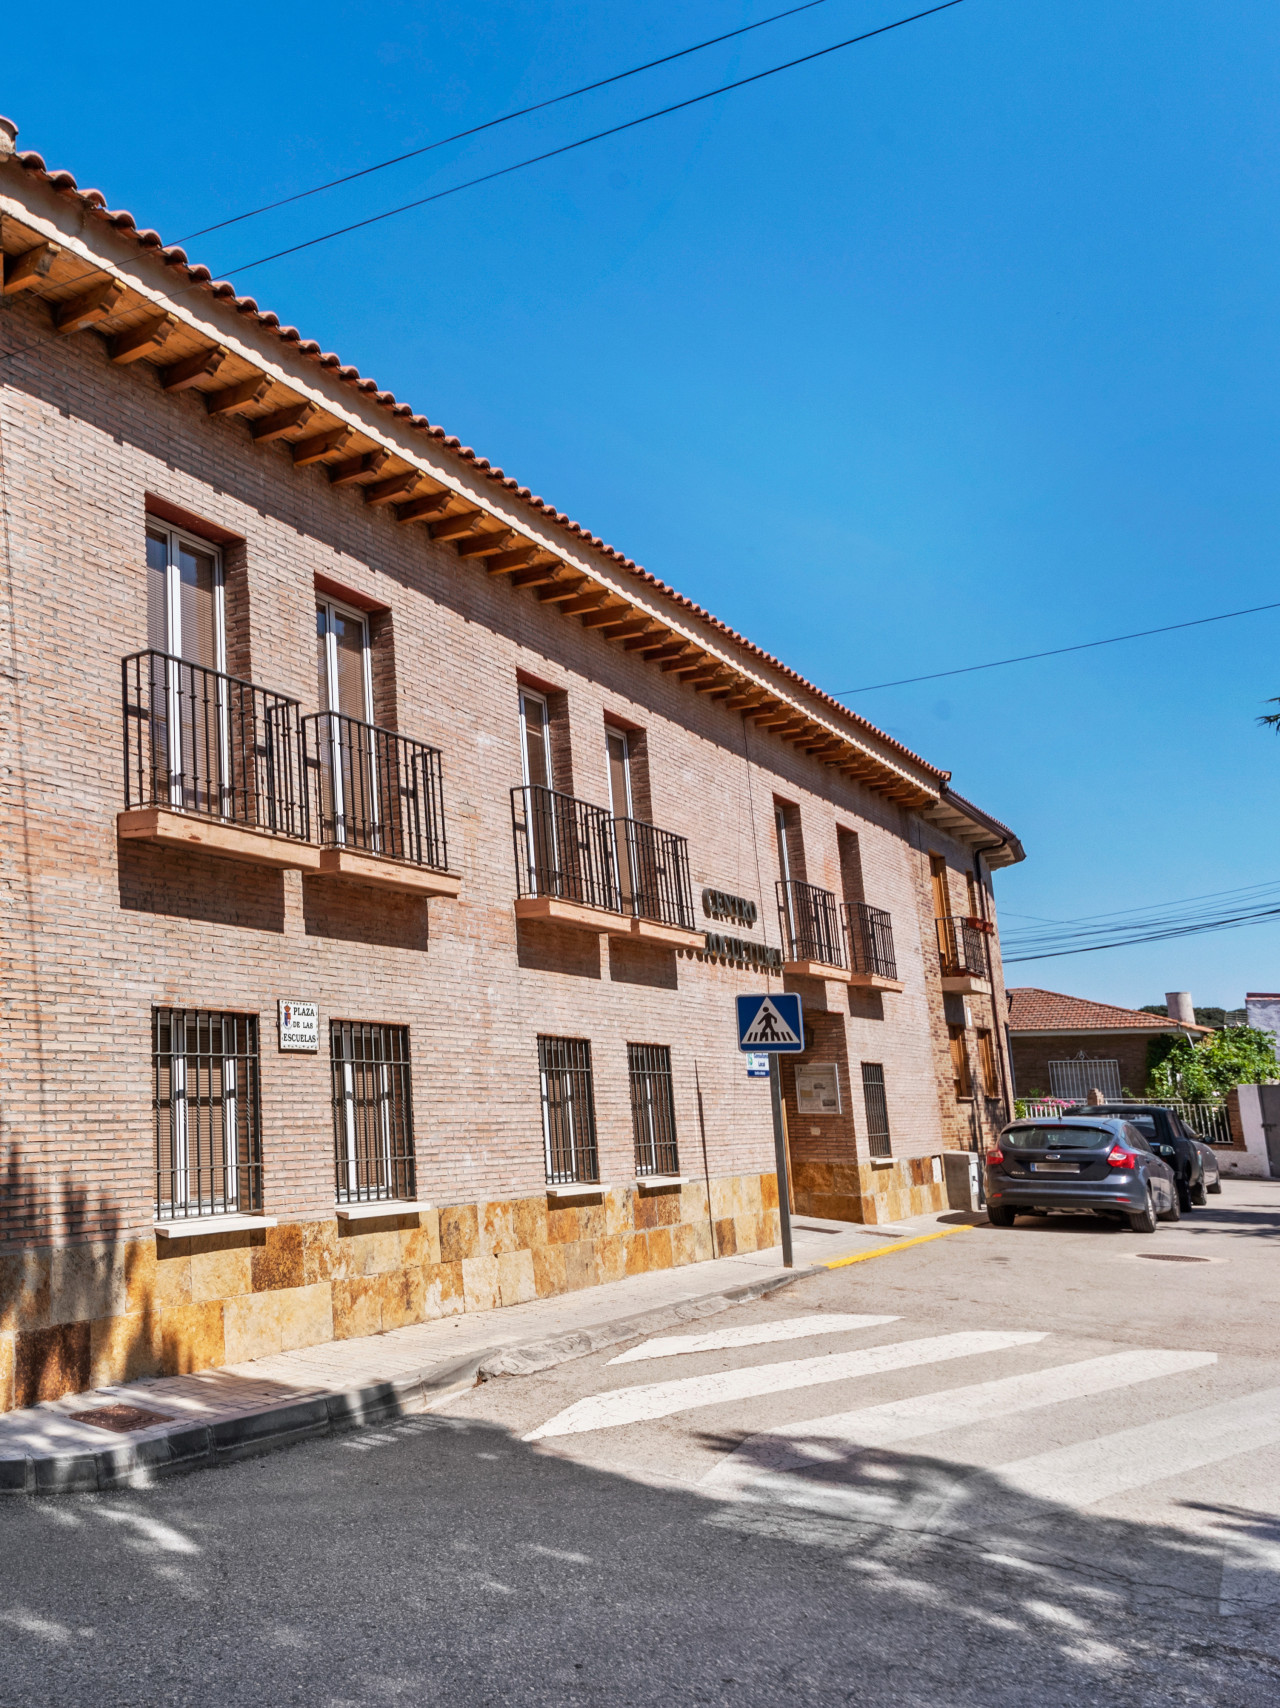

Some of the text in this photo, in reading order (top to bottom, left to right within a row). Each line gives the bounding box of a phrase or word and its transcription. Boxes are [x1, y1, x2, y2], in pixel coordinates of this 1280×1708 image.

[702, 888, 757, 923] CENTRO
[293, 1006, 315, 1017] PLAZA
[292, 1021, 314, 1030] DE LAS
[283, 1033, 317, 1043] ESCUELAS
